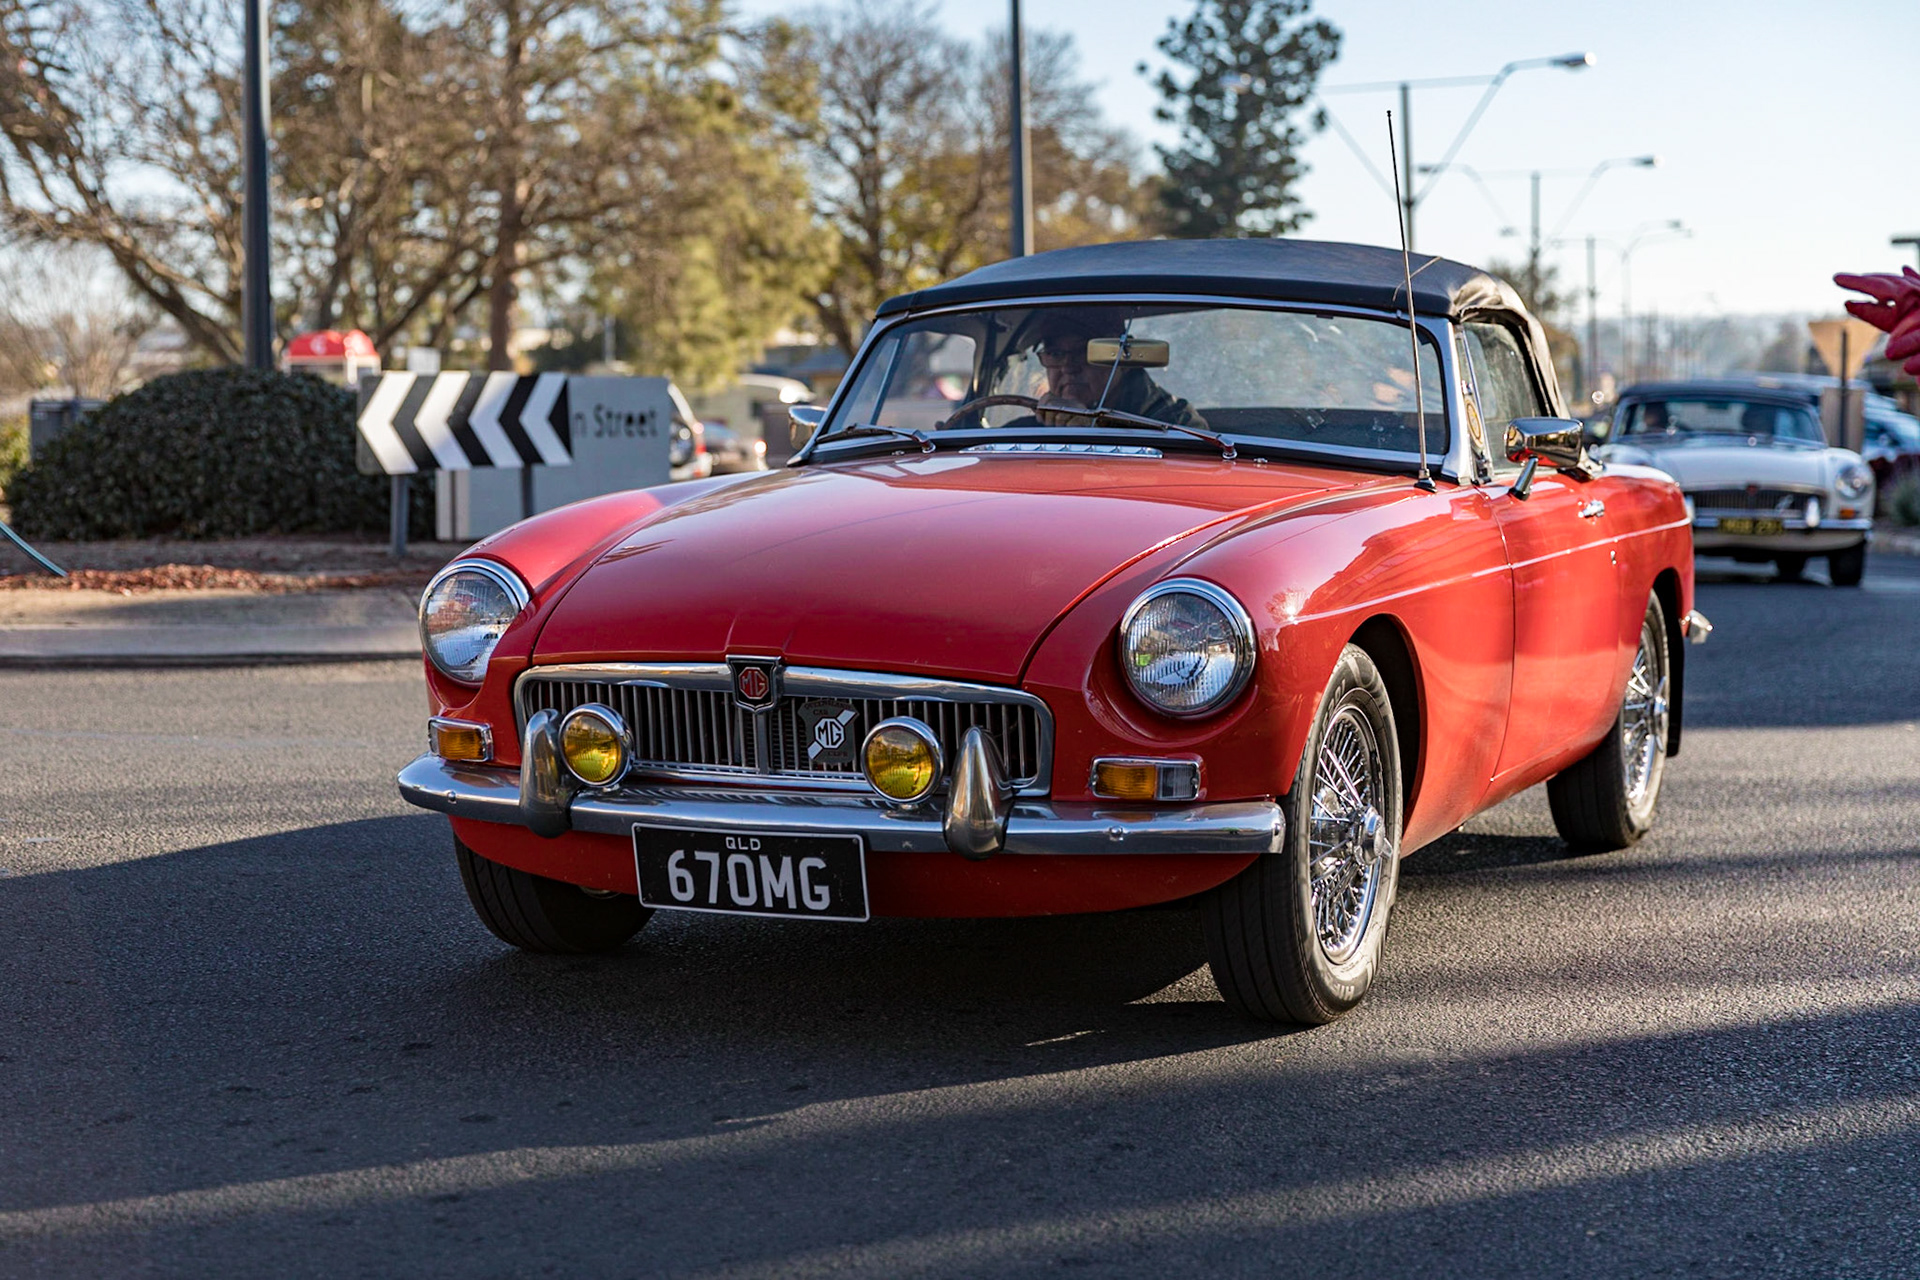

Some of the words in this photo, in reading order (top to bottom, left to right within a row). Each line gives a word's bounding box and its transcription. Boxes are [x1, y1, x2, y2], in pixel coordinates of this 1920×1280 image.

[593, 402, 659, 438] Street
[741, 670, 766, 697] MG
[818, 721, 842, 746] MG
[726, 837, 761, 850] QLD
[667, 850, 831, 911] 670MG
